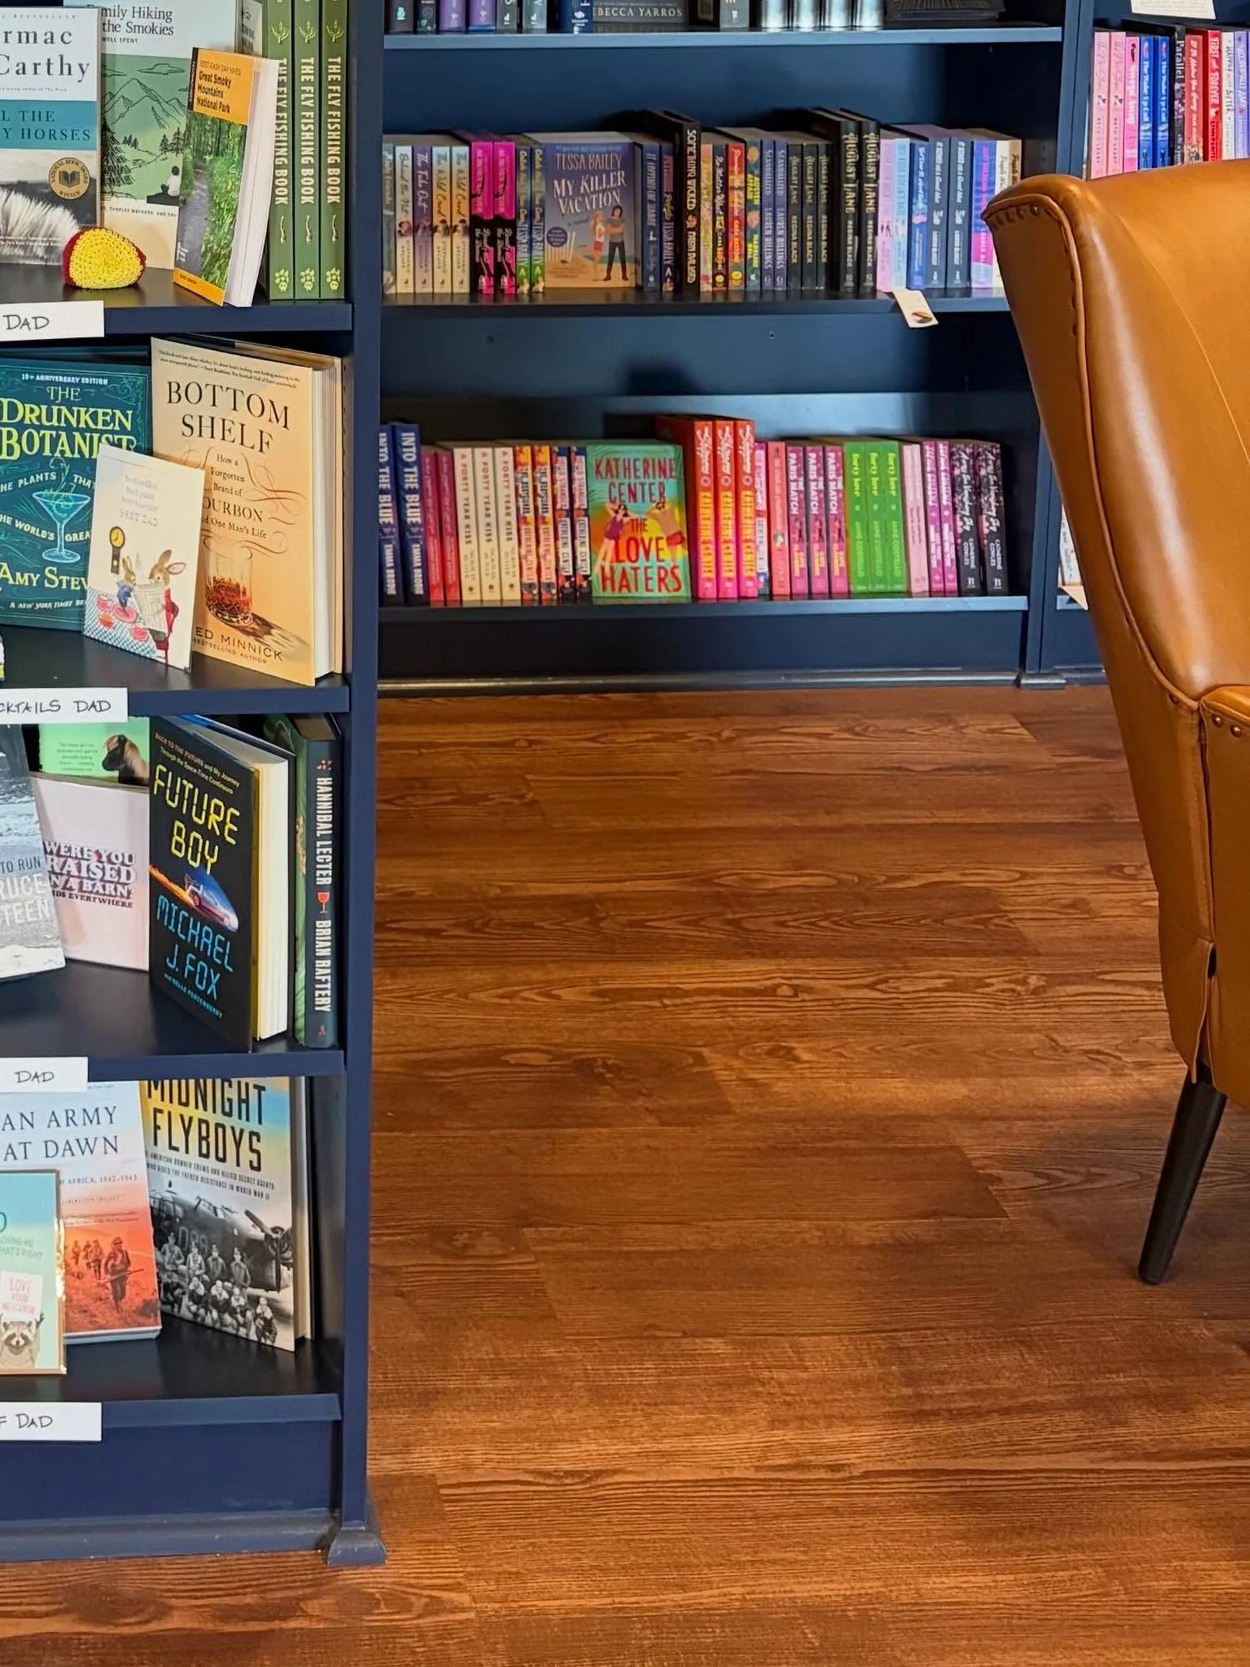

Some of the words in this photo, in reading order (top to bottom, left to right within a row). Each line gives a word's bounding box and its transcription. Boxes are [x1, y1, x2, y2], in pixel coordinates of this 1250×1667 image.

[300, 57, 315, 81] THE
[300, 85, 314, 108] FLY
[18, 110, 55, 122] THE
[20, 128, 91, 141] HORSES
[300, 111, 314, 164] FISHING
[300, 168, 314, 205] BOOK
[553, 180, 576, 198] MY
[580, 171, 626, 194] KILLER
[558, 192, 622, 215] VACATION
[3, 314, 50, 331] DAD
[46, 386, 82, 403] THE
[166, 380, 291, 430] BOTTOM
[180, 414, 274, 455] SHELF
[594, 457, 677, 480] KATHERINE
[608, 481, 666, 504] CENTER
[629, 517, 649, 533] THE
[612, 535, 665, 565] LOVE
[598, 563, 683, 595] HATERS
[74, 699, 112, 712] DAD
[153, 764, 240, 846] FUTURE
[316, 776, 334, 840] HANNIBAL
[170, 821, 220, 876] BOY
[0, 861, 15, 874] TO
[18, 856, 42, 870] RUN
[316, 843, 333, 886] LECTER
[157, 895, 234, 973] MICHAEL
[316, 920, 331, 956] BRIAN
[166, 943, 180, 970] J.
[182, 953, 220, 1001] FOX
[315, 960, 331, 1013] RAFTERY
[14, 1068, 55, 1085] DAD
[1, 1111, 35, 1132] AN
[45, 1106, 119, 1128] ARMY
[2, 1142, 33, 1162] AT
[43, 1135, 120, 1158] DAWN
[152, 1108, 263, 1173] FLYBOYS
[16, 1413, 54, 1429] DAD
